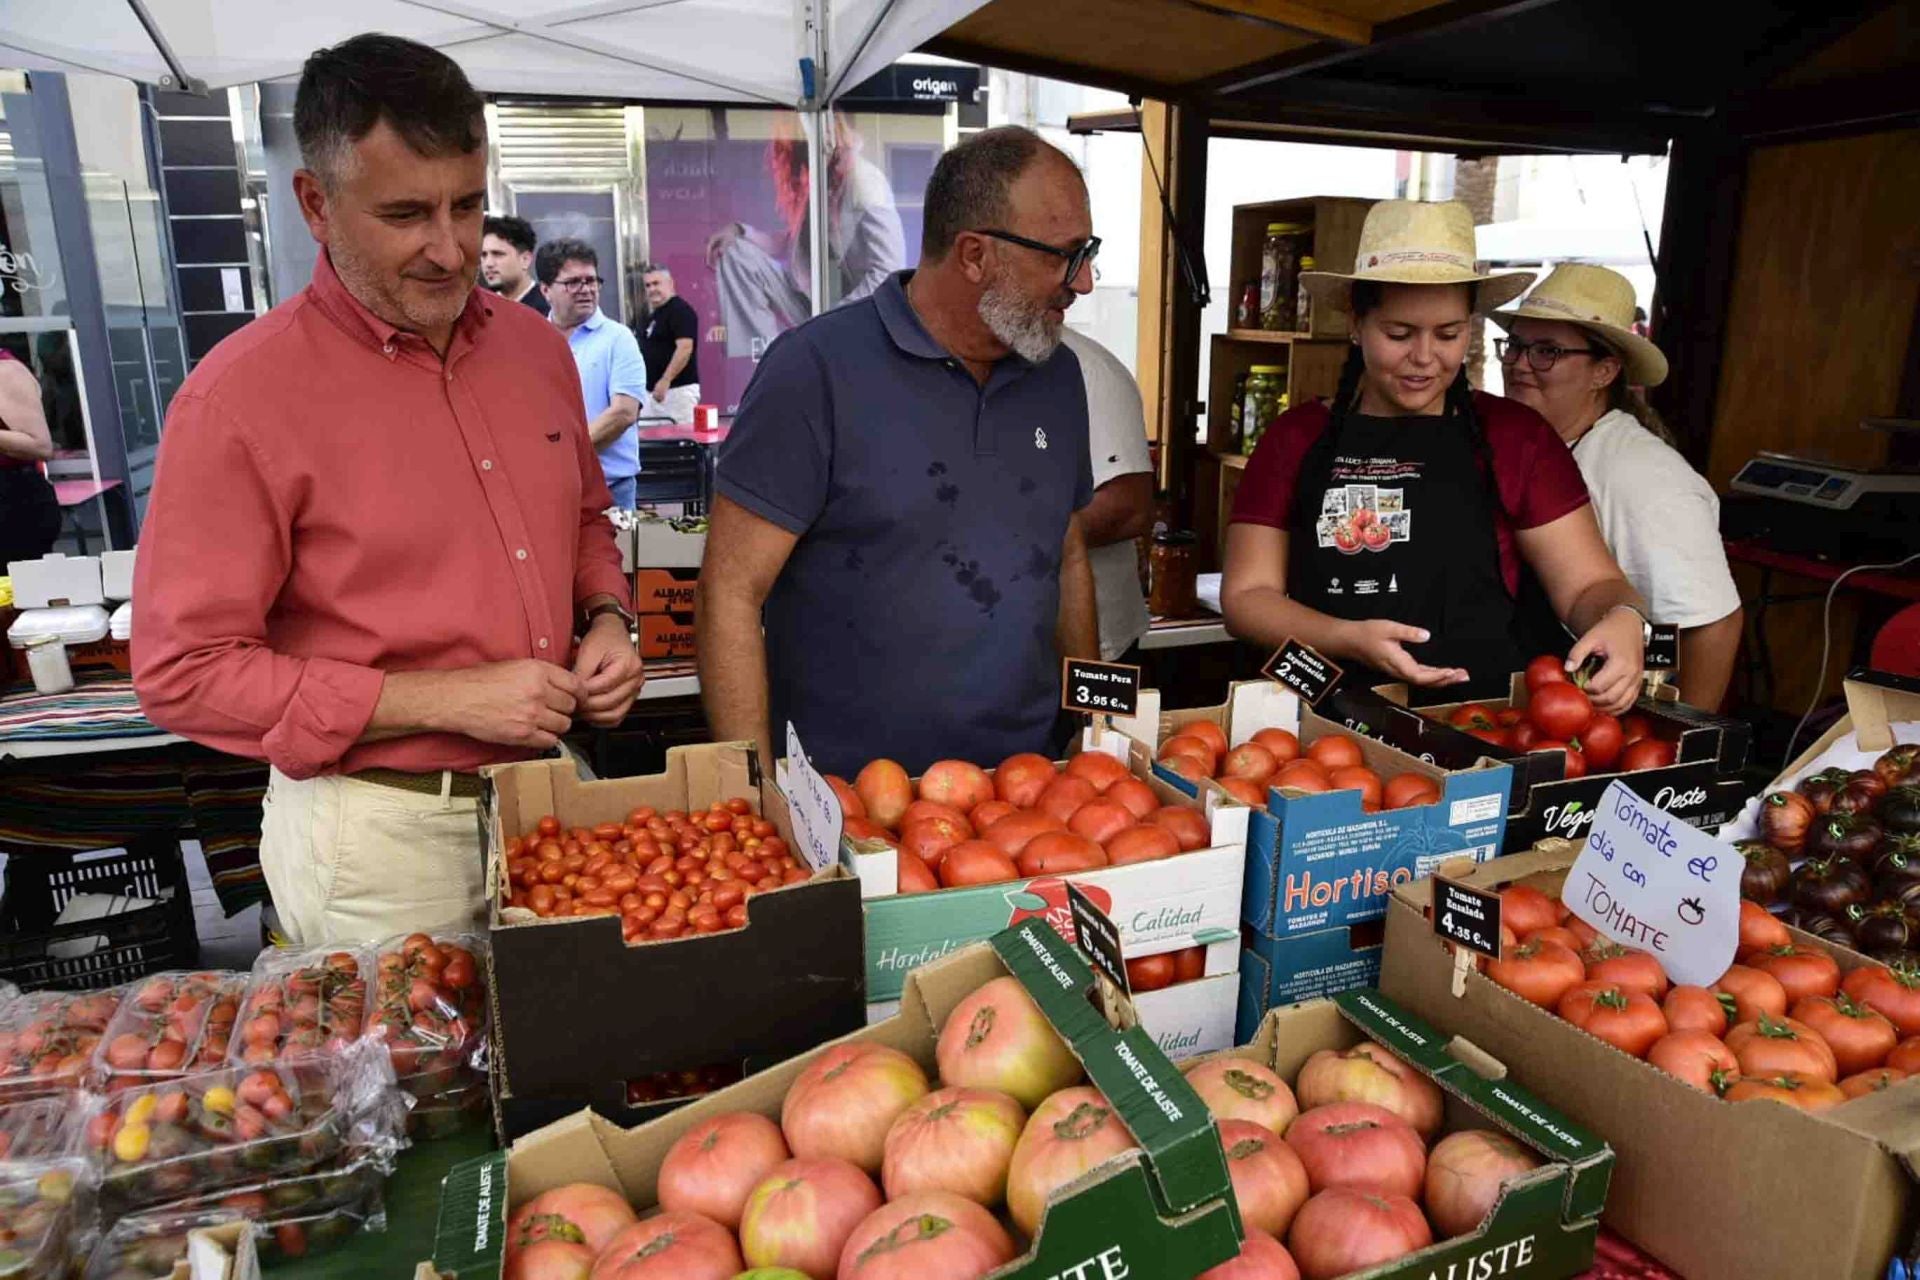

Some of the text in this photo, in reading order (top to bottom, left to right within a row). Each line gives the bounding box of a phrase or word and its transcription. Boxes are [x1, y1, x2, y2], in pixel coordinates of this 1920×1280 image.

[912, 76, 958, 95] origen
[1299, 649, 1325, 670] Tomate
[1073, 668, 1132, 684] Tomate Pera
[1274, 661, 1302, 686] 2.95
[1076, 685, 1108, 706] 3.95
[1654, 786, 1708, 813] Oeste
[1622, 862, 1646, 888] con
[1687, 855, 1718, 882] el
[1446, 897, 1485, 920] Ensalada
[1448, 886, 1482, 907] Tomate
[1132, 903, 1205, 933] Calidad
[1585, 871, 1669, 951] TOMATE
[1442, 911, 1471, 940] 4.35
[1019, 926, 1047, 957] TOMATE
[1040, 951, 1055, 967] DE
[1049, 963, 1074, 990] ALISTE
[1357, 995, 1427, 1046] TOMATE DE ALISTE
[1114, 1040, 1148, 1080] TOMATE
[1141, 1075, 1160, 1093] DE
[1150, 1090, 1184, 1122] ALISTE
[1491, 1087, 1583, 1148] TOMATE DE ALISTE
[474, 1160, 493, 1252] TOMATE DE ALISTE
